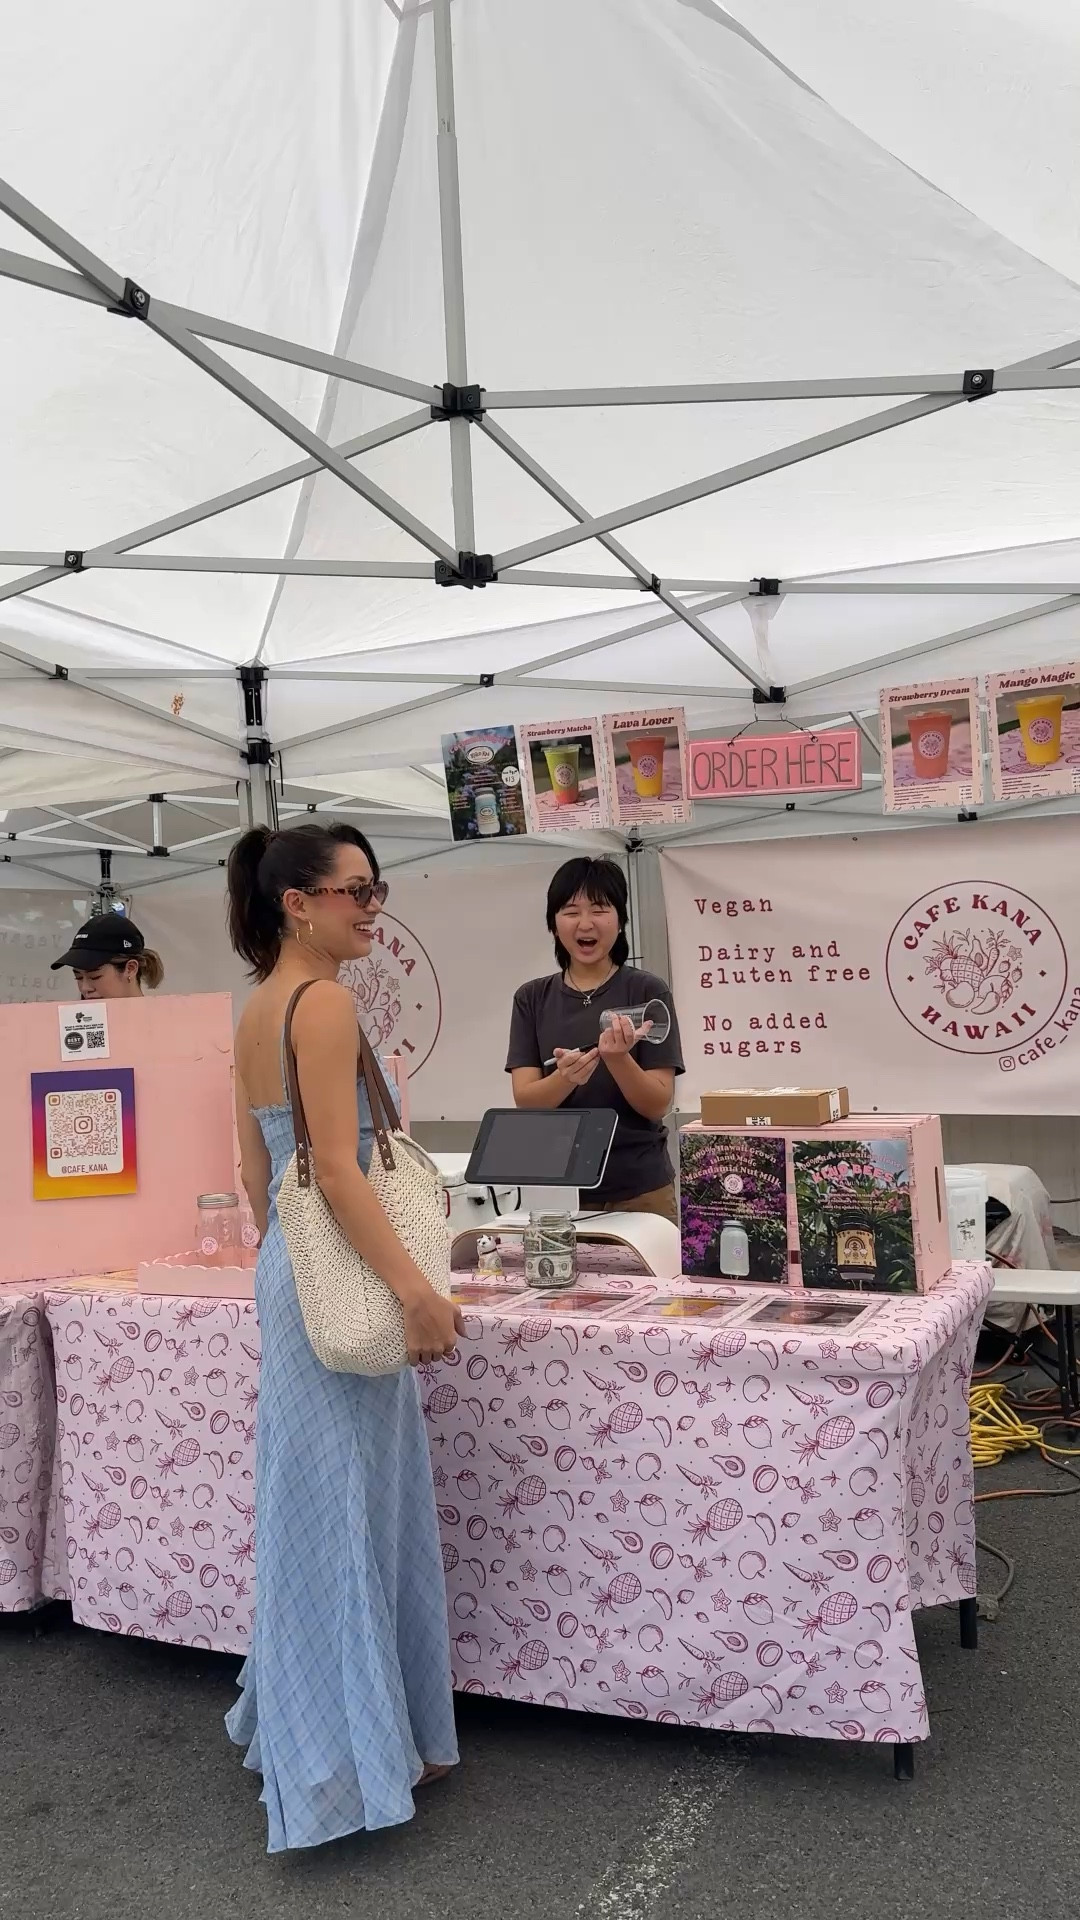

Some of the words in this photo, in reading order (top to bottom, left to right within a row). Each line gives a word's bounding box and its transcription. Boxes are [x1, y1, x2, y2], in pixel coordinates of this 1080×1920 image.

[999, 677, 1038, 690] Mango
[1040, 671, 1076, 684] Magic
[888, 691, 939, 703] Strawberry
[940, 687, 970, 697] Dream
[527, 727, 566, 737] Strawberry
[567, 724, 592, 733] Matcha
[613, 720, 640, 730] Lava
[641, 715, 675, 728] Lover
[693, 747, 779, 791] ORDER
[786, 741, 853, 785] HERE
[694, 898, 773, 917] Vegan
[903, 896, 961, 950] CAFE
[971, 894, 1042, 946] KANA
[372, 926, 416, 977] ANA
[698, 943, 775, 963] Dairy
[792, 940, 841, 958] and
[700, 966, 793, 989] gluten
[808, 965, 871, 982] free
[703, 1015, 732, 1032] No
[749, 1012, 828, 1030] added
[921, 1003, 1036, 1040] HAWAII
[703, 1040, 802, 1057] sugars
[710, 1154, 735, 1165] Island
[736, 1154, 757, 1167] Made
[716, 1144, 748, 1152] Hawaii
[749, 1147, 777, 1164] Grown
[61, 1163, 108, 1174] @CAFE_KANA
[685, 1164, 738, 1181] Macadamia
[740, 1166, 758, 1176] Nut
[758, 1171, 782, 1187] Milk
[811, 1163, 849, 1184] KIND
[852, 1163, 894, 1182] BEES
